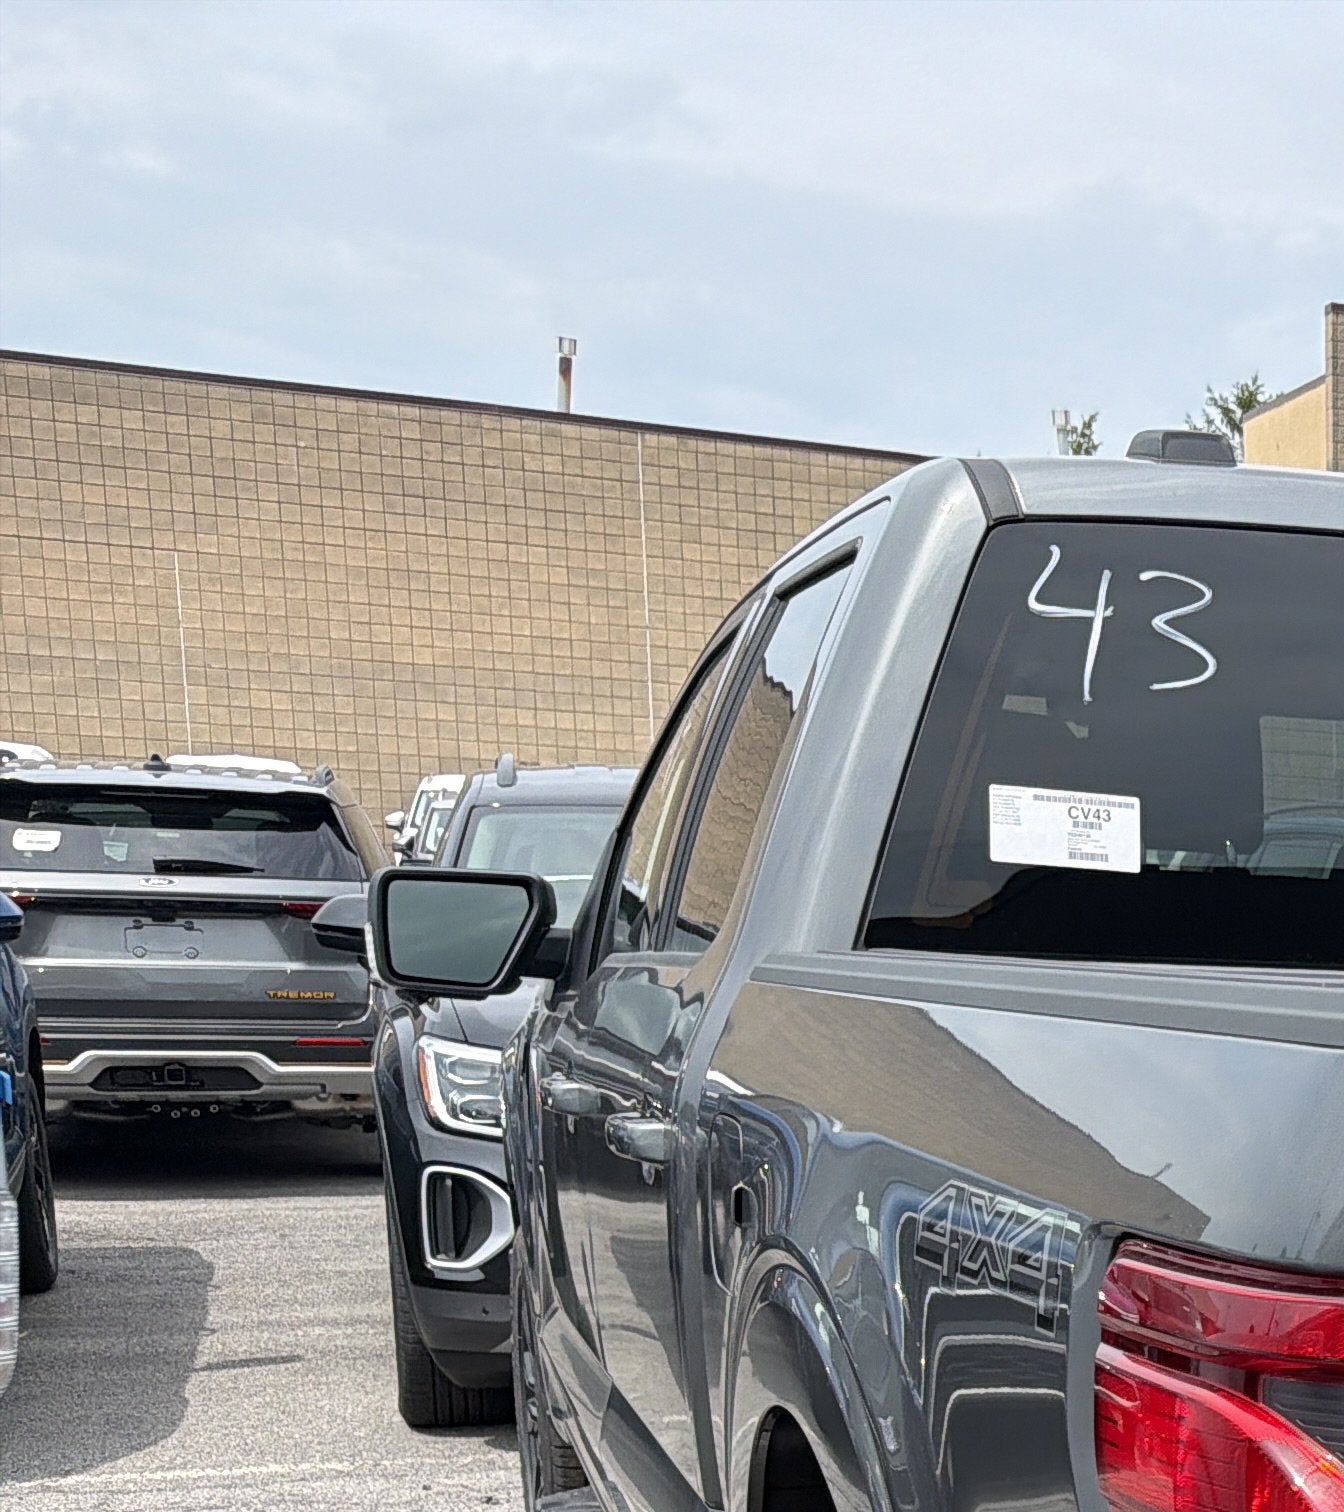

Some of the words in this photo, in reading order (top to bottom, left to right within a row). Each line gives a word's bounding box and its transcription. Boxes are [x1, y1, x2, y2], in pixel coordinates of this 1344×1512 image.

[1027, 544, 1218, 705] 43
[1067, 805, 1112, 823] CV43
[265, 990, 337, 1000] TREMOR
